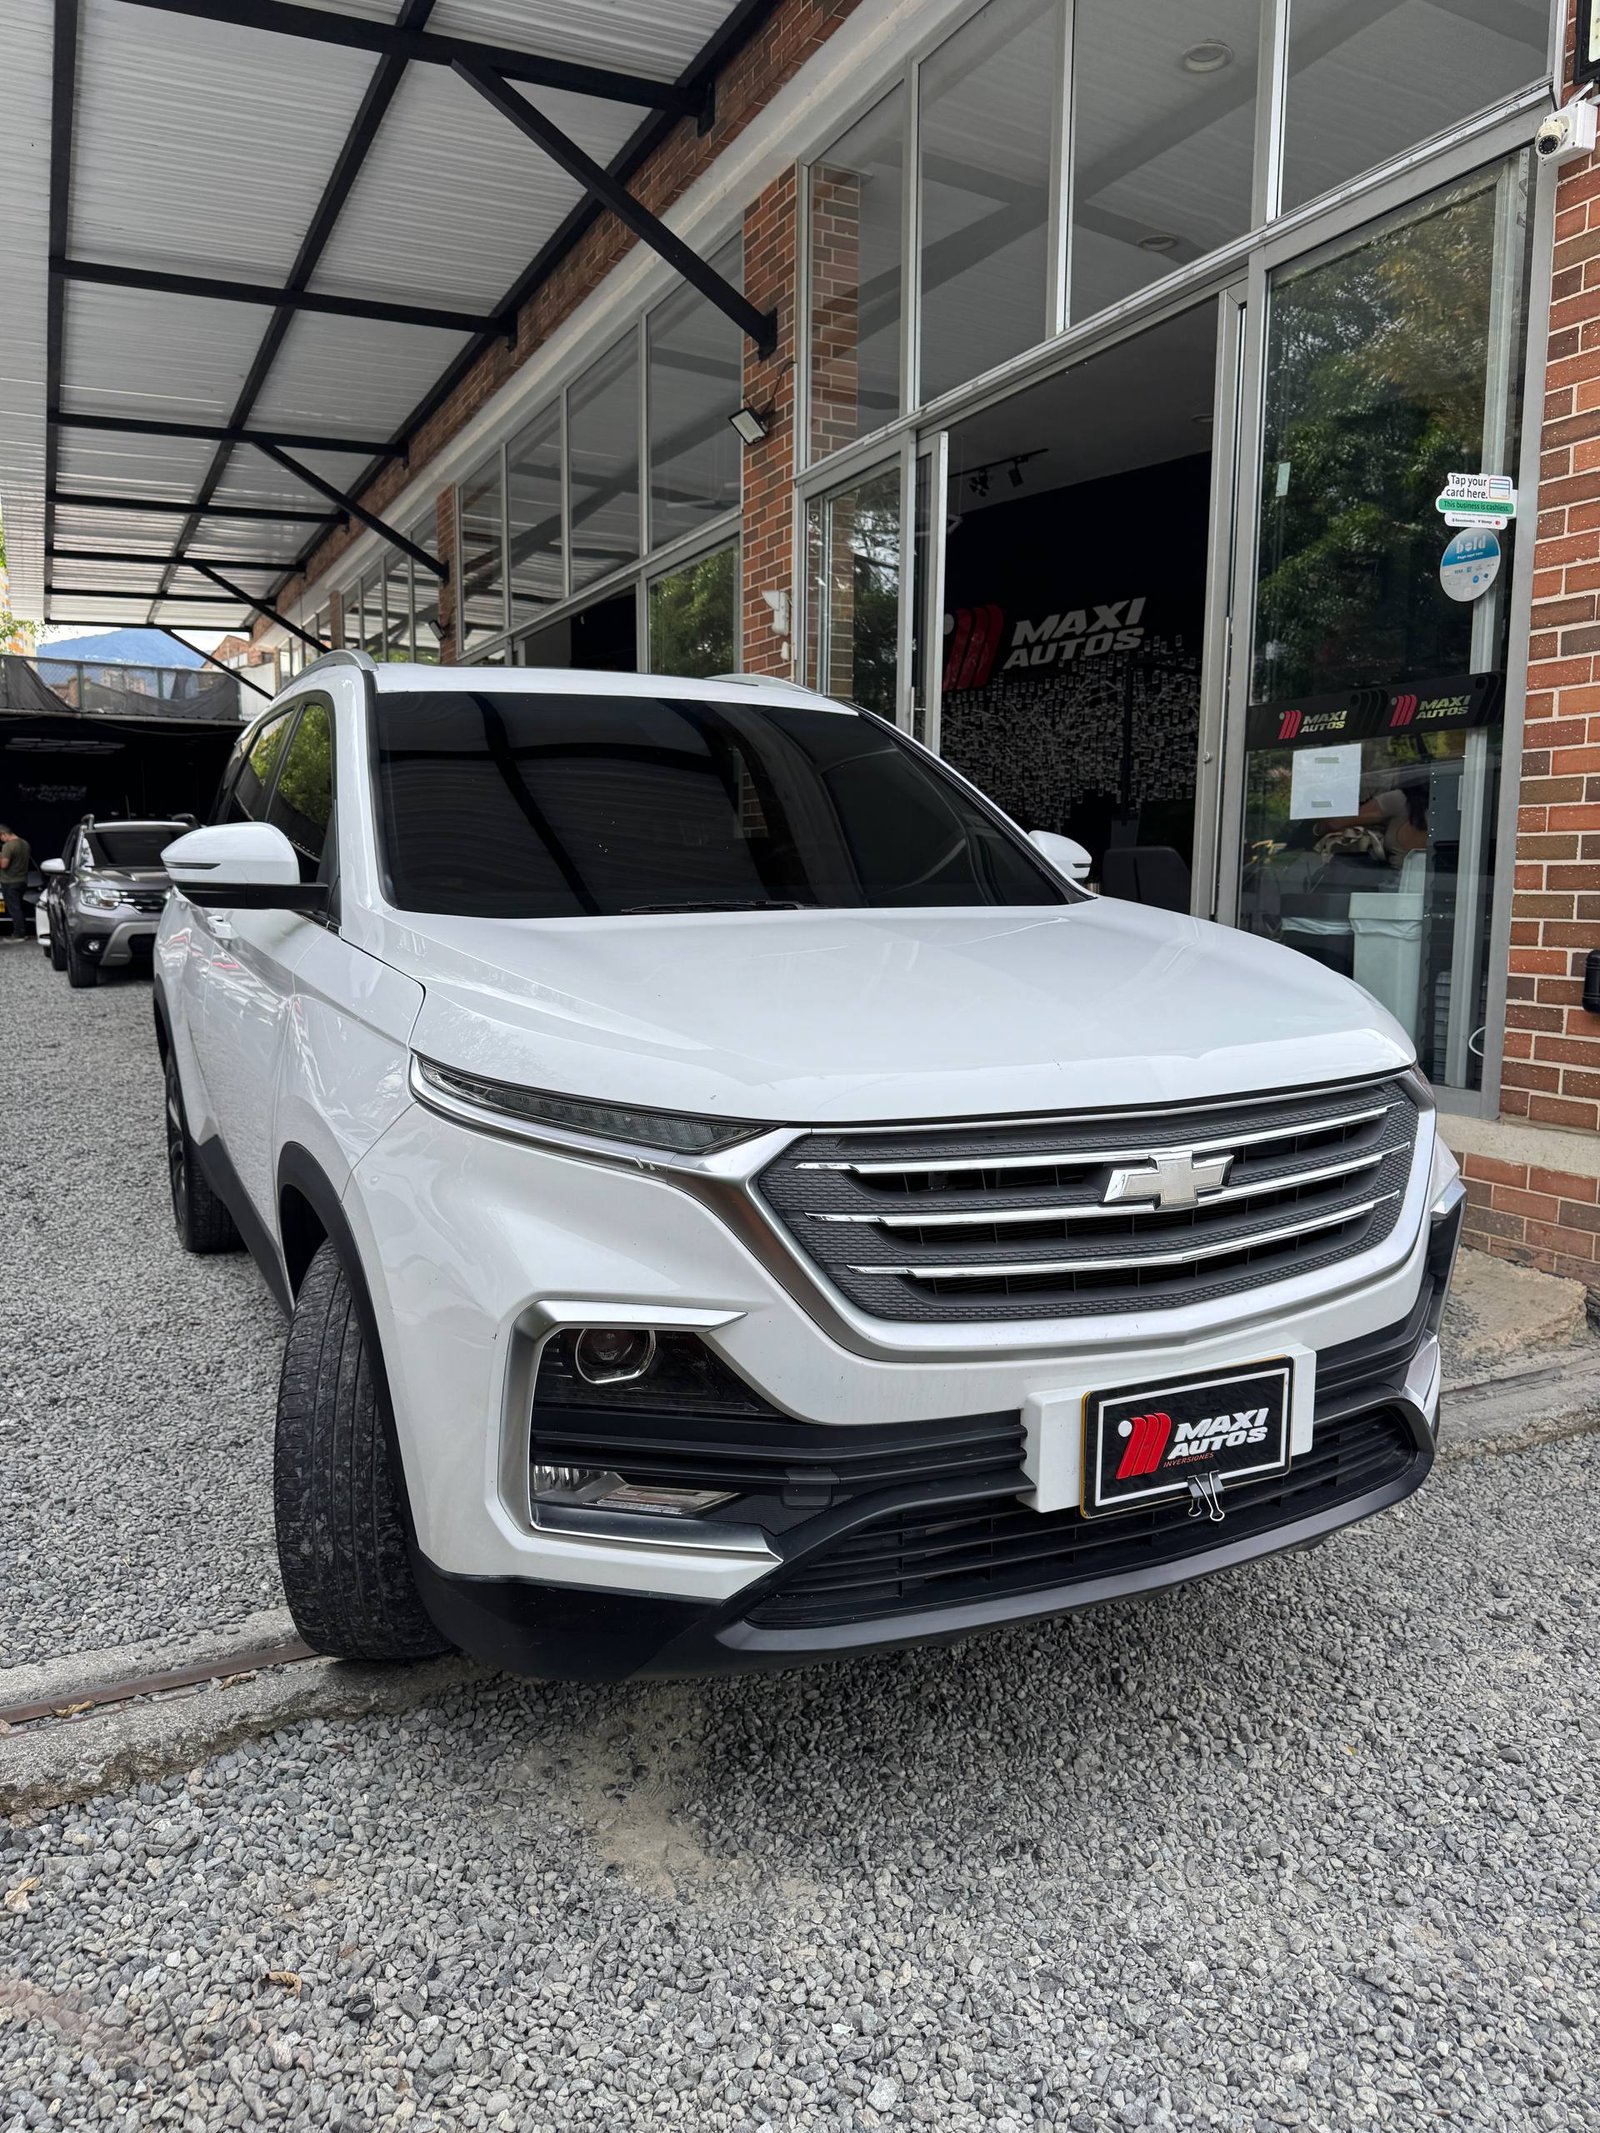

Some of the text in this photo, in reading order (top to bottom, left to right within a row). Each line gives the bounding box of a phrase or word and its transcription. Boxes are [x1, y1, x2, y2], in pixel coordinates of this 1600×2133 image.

[1451, 475, 1487, 487] Tap your
[1446, 488, 1488, 499] card here.
[1444, 500, 1456, 508] This
[1456, 501, 1480, 510] business
[1456, 535, 1486, 553] bold
[1011, 597, 1147, 647] MAXI
[1003, 627, 1145, 670] AUTOS
[1420, 695, 1471, 710] MAXI
[1302, 710, 1348, 725] MAXI
[1415, 706, 1470, 720] AUTOS
[1300, 721, 1346, 734] AUTOS
[1174, 1407, 1270, 1443] MAXI
[1167, 1426, 1268, 1460] AUTOS
[1163, 1451, 1215, 1468] INVERSIONES
